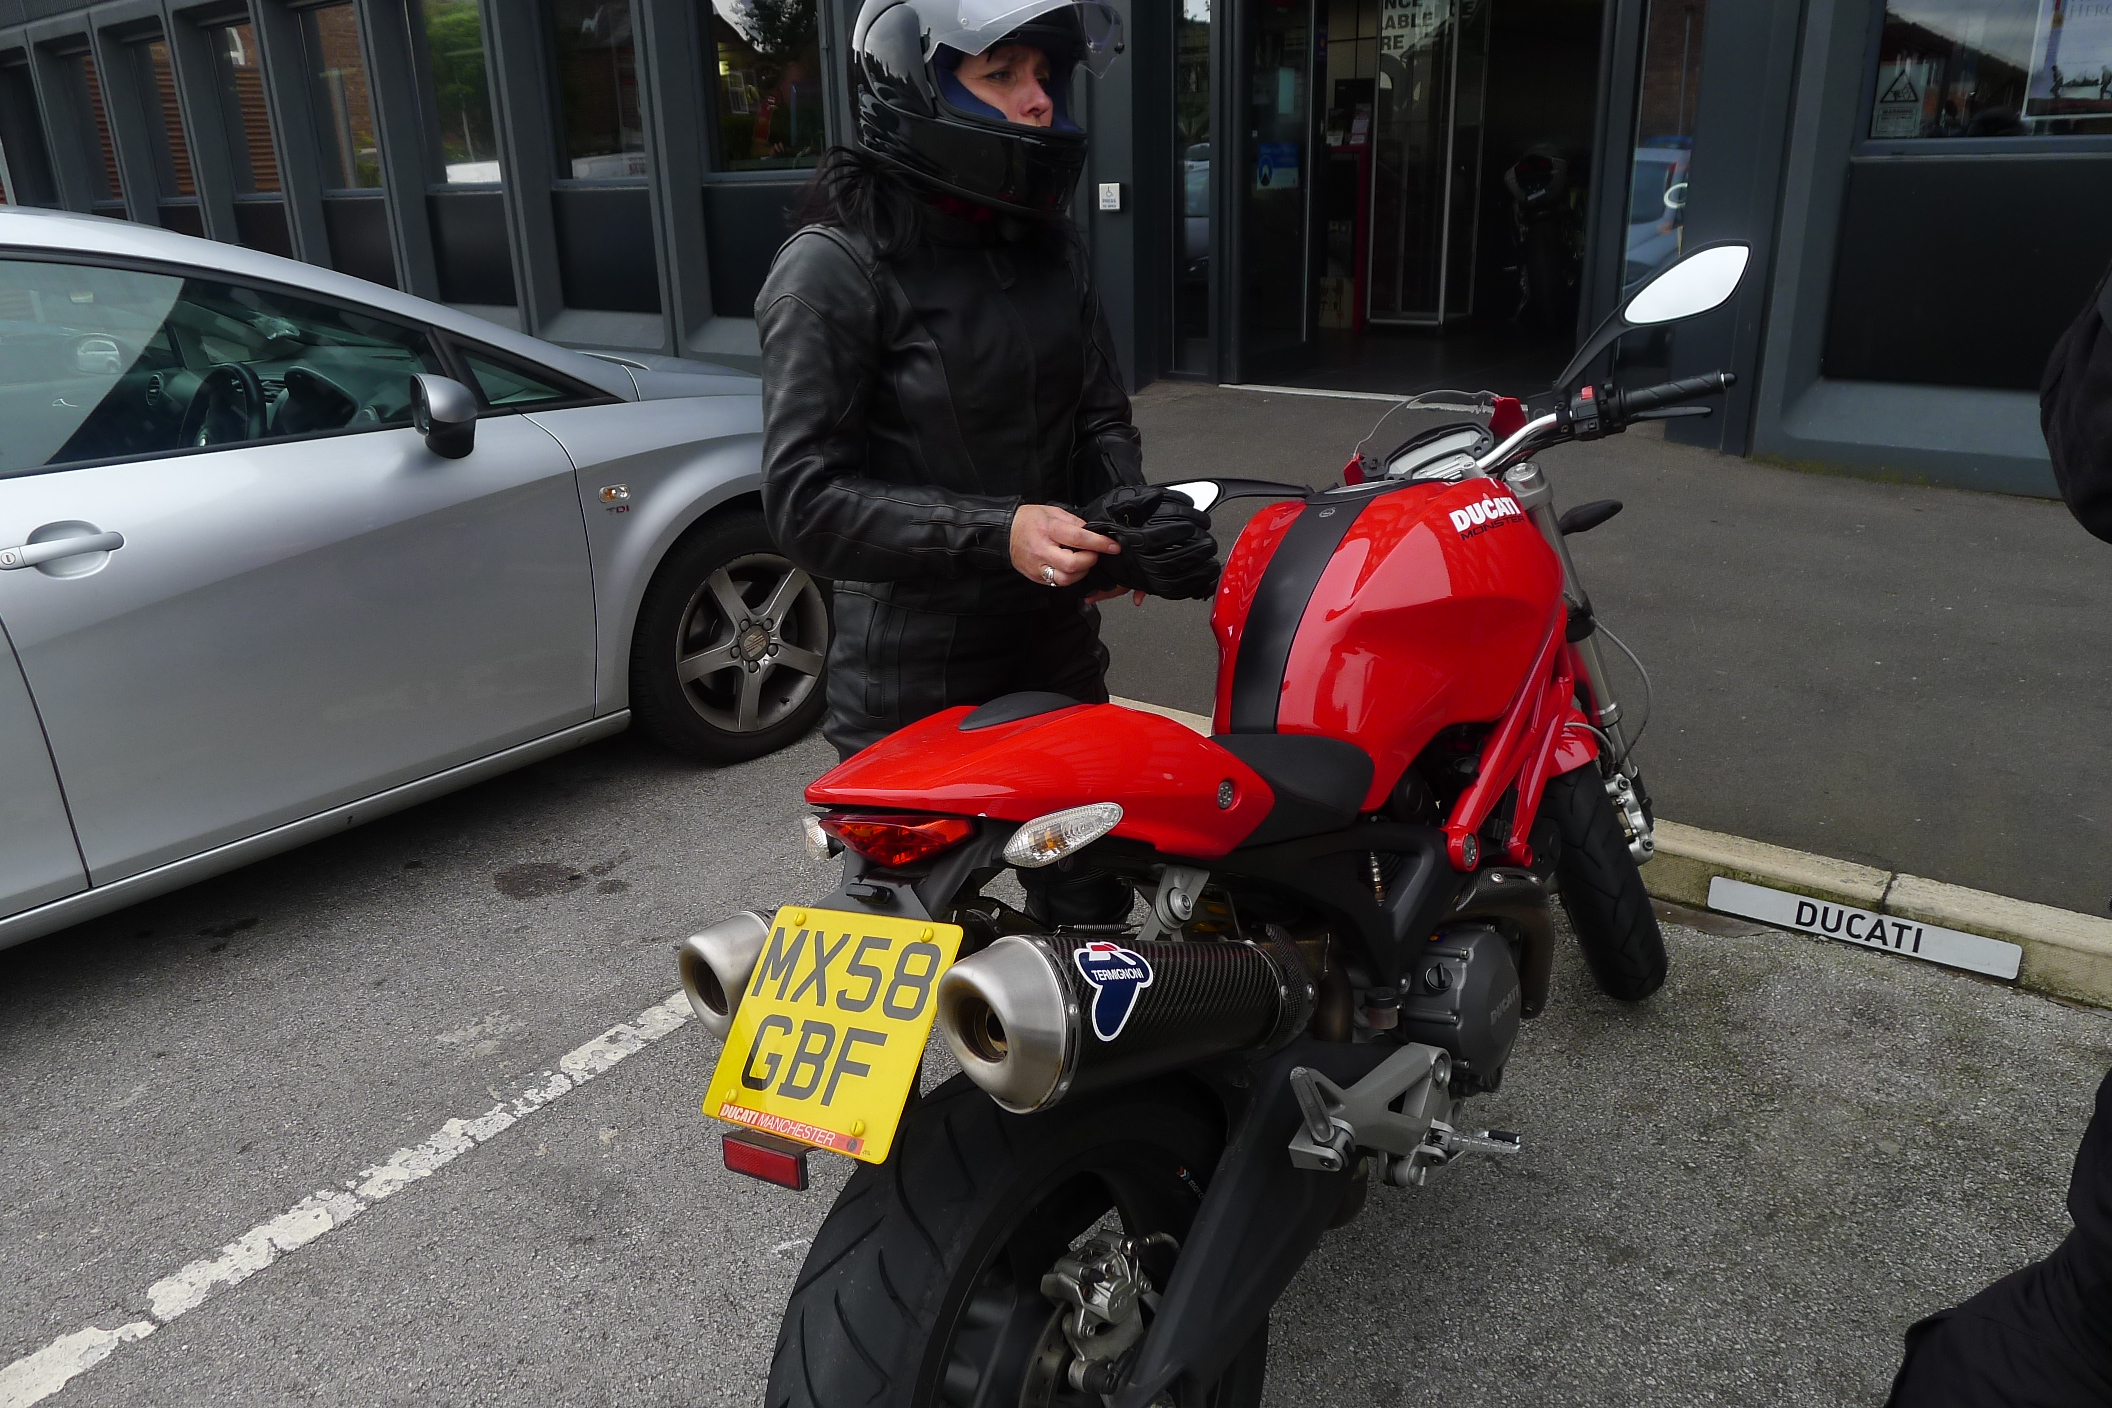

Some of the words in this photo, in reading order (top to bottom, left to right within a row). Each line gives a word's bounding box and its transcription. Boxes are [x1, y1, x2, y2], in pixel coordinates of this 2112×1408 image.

[606, 505, 630, 514] TDI
[1449, 497, 1521, 532] DUCATI
[1461, 515, 1525, 540] MONSTER
[1795, 900, 1923, 953] DUCATI
[751, 926, 942, 1022] MX58
[1091, 967, 1145, 982] TERMIGNONI
[740, 1013, 889, 1107] GBF
[720, 1103, 760, 1125] DUCATI
[757, 1113, 836, 1147] MANCHESTER
